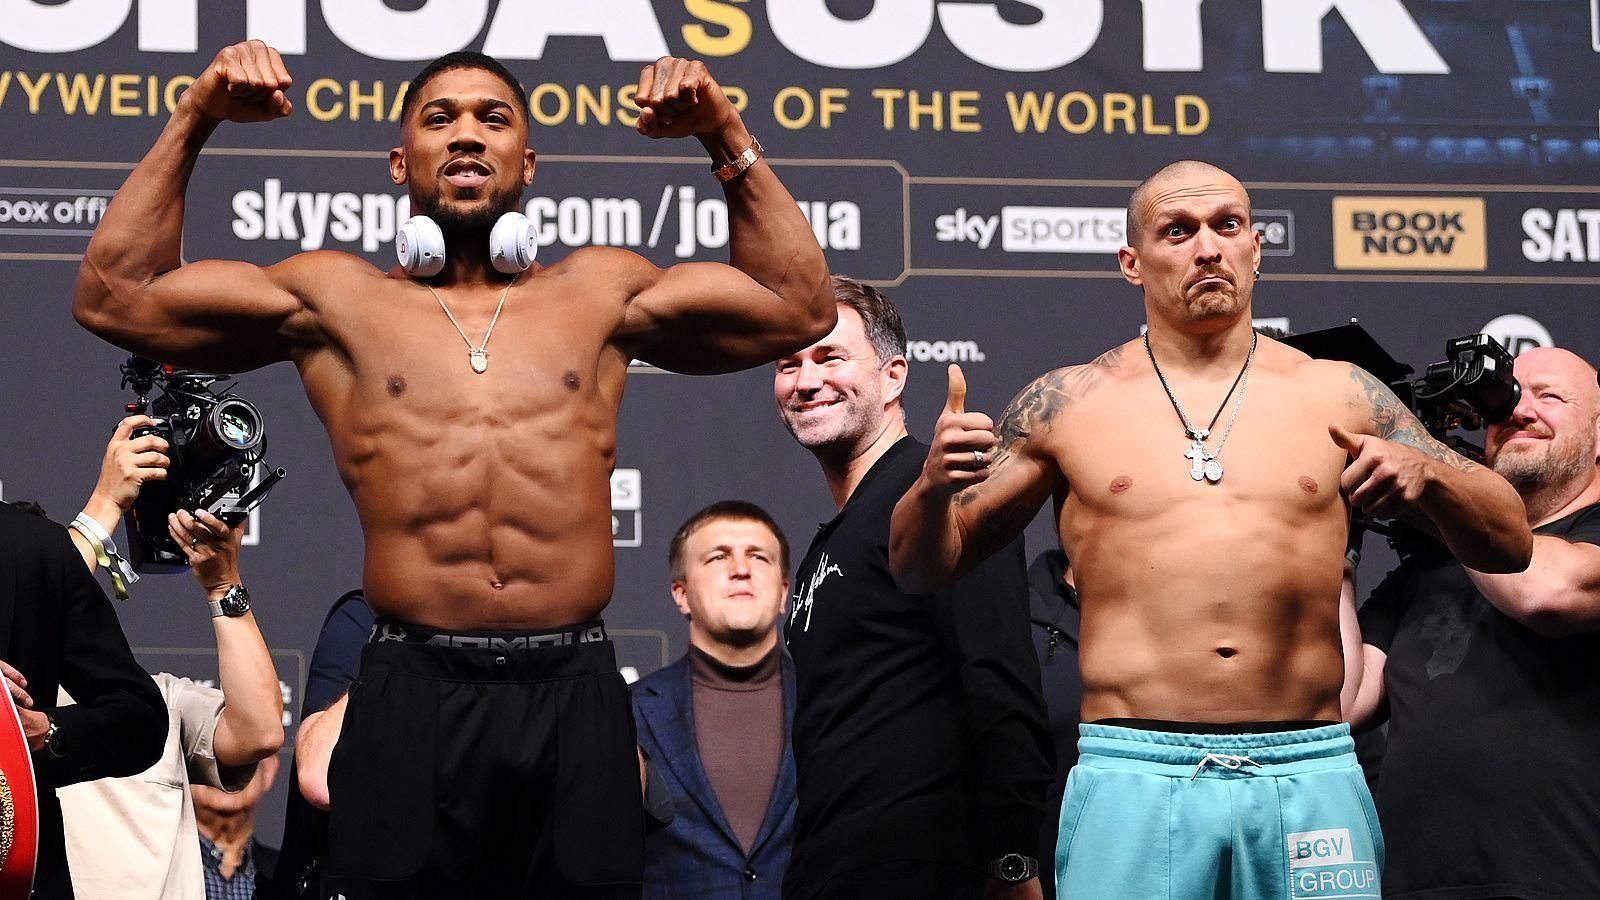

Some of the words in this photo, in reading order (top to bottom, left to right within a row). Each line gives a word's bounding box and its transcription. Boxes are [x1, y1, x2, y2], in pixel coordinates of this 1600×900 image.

[773, 86, 849, 130] OF
[872, 88, 982, 133] THE
[1005, 90, 1210, 136] WORLD
[934, 207, 1000, 250] sky
[1011, 213, 1124, 244] sports
[1352, 211, 1465, 232] BOOK
[1362, 235, 1455, 254] NOW
[1295, 837, 1344, 859] BGV
[1299, 868, 1375, 892] GROUP
